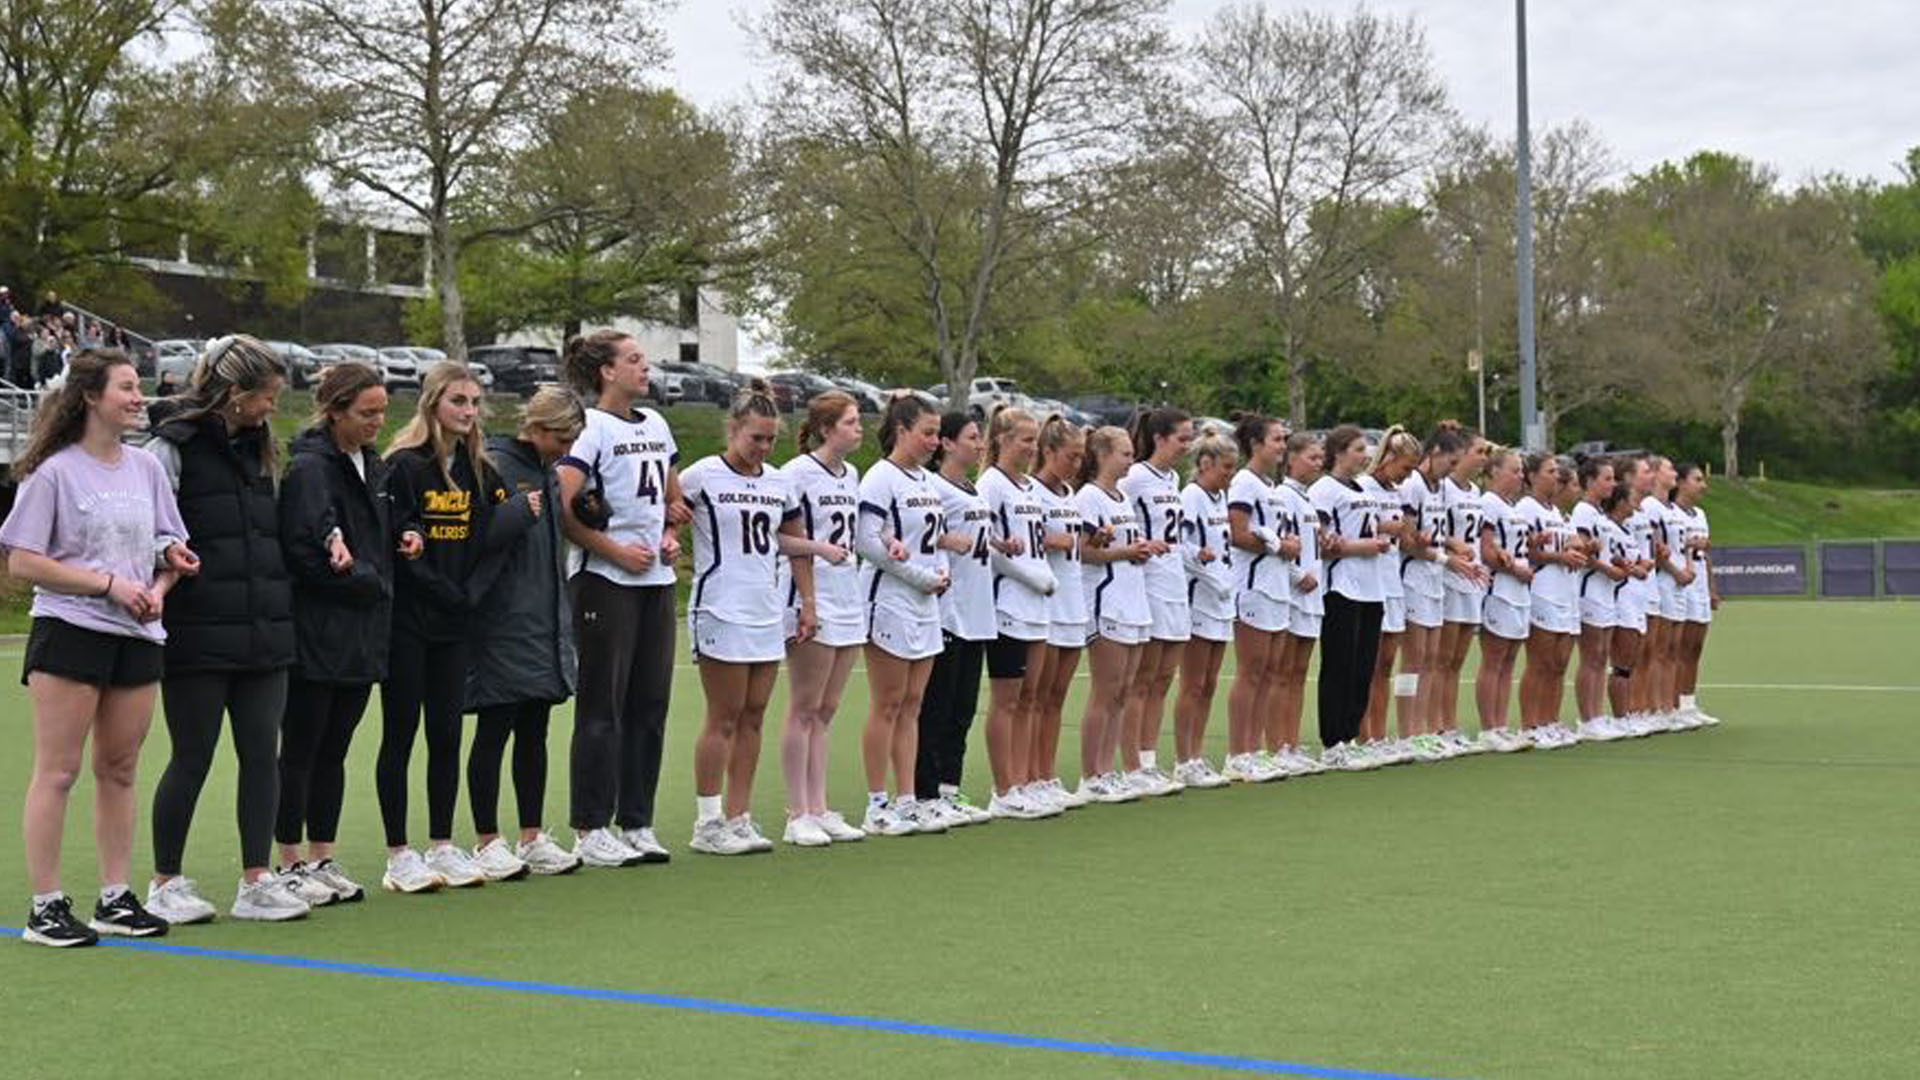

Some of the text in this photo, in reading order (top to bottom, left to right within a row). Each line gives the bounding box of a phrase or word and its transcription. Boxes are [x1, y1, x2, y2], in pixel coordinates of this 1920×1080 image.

[613, 443, 647, 457] GOLDEN
[718, 493, 758, 504] GOLDEN
[740, 510, 771, 556] 10
[1711, 565, 1744, 575] NDER
